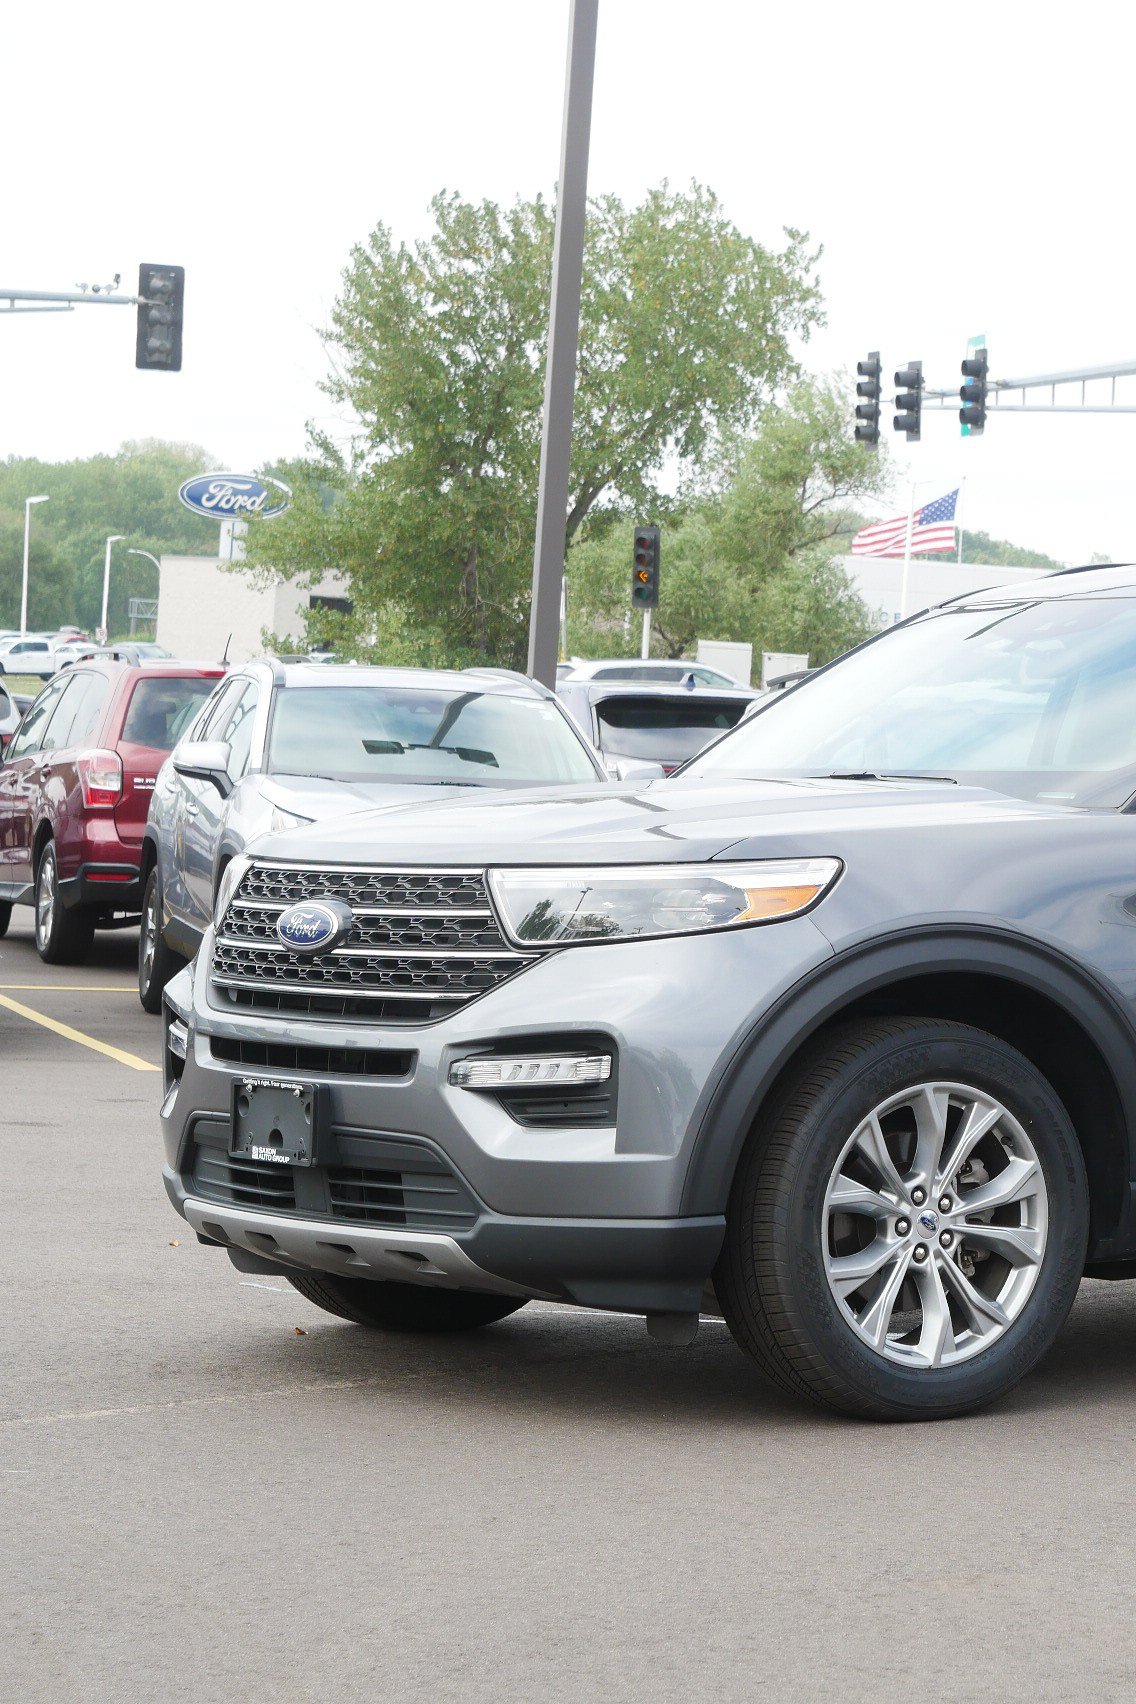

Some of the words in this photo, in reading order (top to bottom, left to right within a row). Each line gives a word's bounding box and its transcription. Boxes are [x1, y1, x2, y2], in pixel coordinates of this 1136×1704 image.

[200, 479, 267, 511] Ford
[285, 912, 321, 938] Ford
[258, 1146, 277, 1155] SAXON
[258, 1153, 272, 1161] AUTO
[271, 1155, 291, 1164] GROUP
